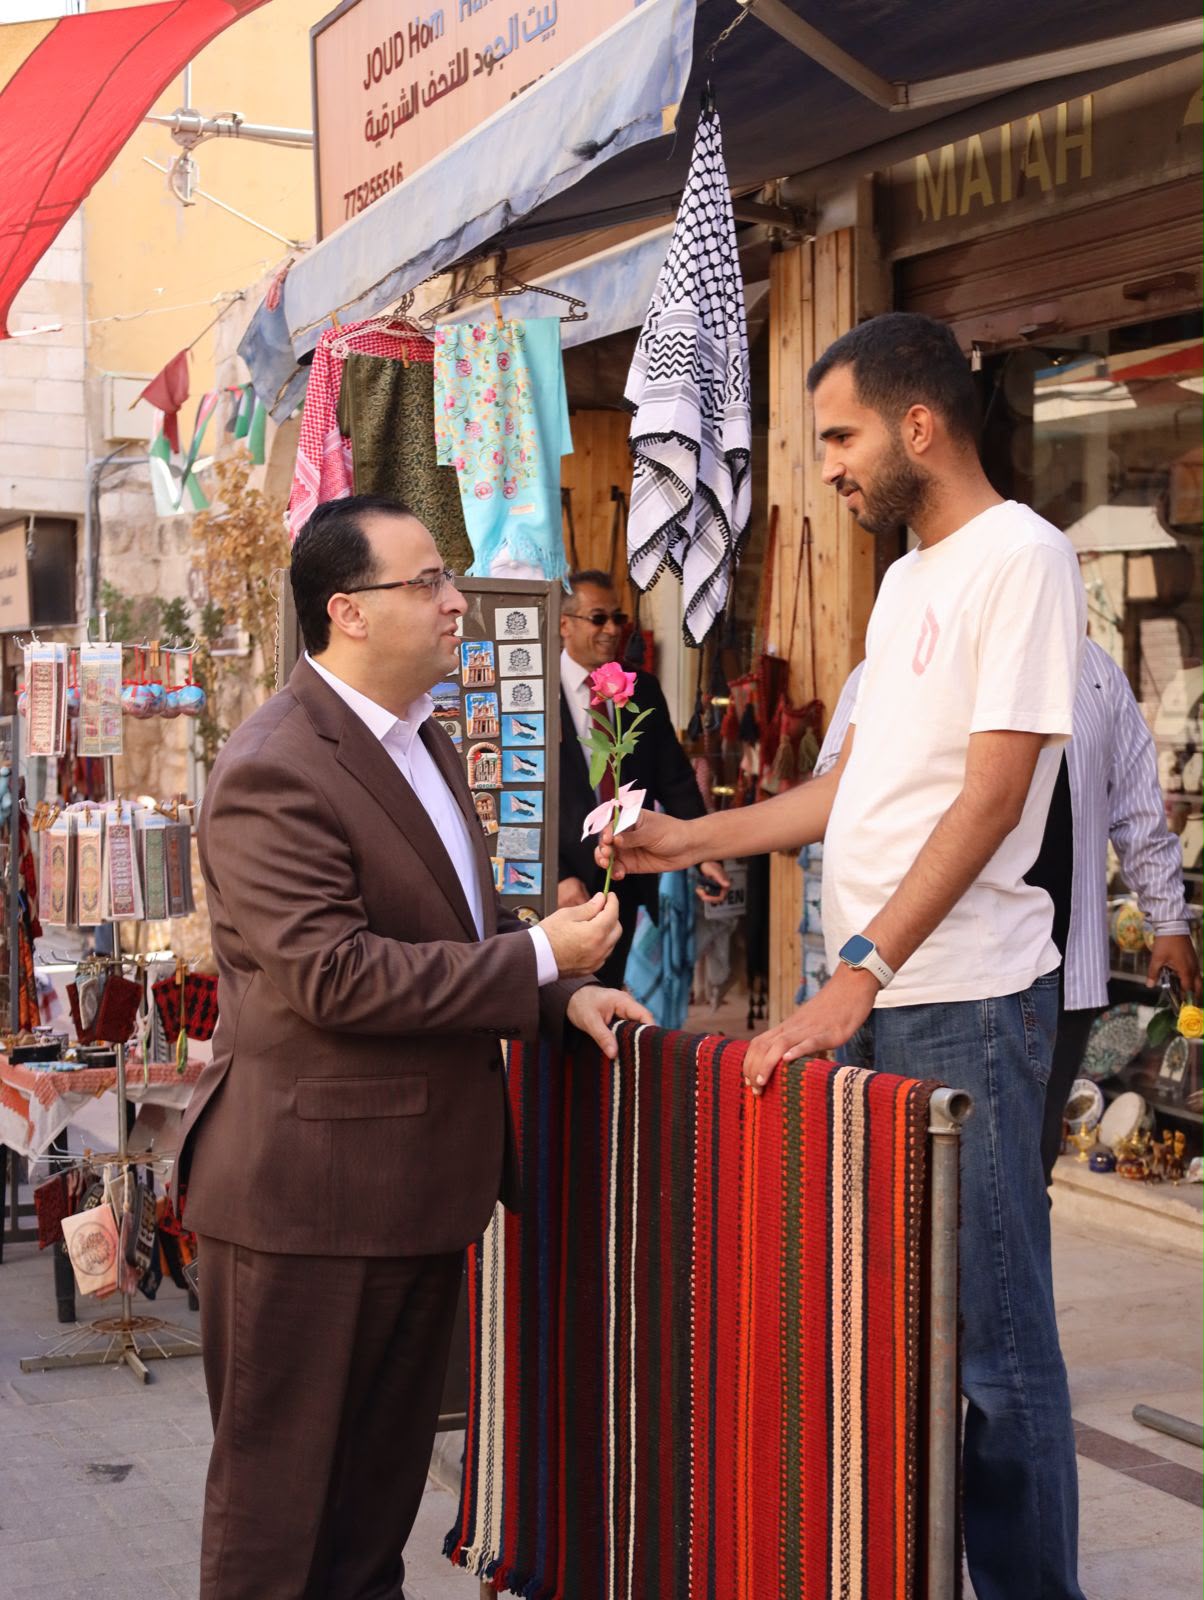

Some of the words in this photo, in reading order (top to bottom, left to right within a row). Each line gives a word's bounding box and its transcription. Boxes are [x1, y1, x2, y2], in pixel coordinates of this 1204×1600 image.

[473, 13, 519, 77] الجود
[521, 0, 558, 43] بيت
[363, 30, 404, 90] JOUD
[421, 47, 469, 108] للتحف
[364, 81, 419, 149] الشرقية
